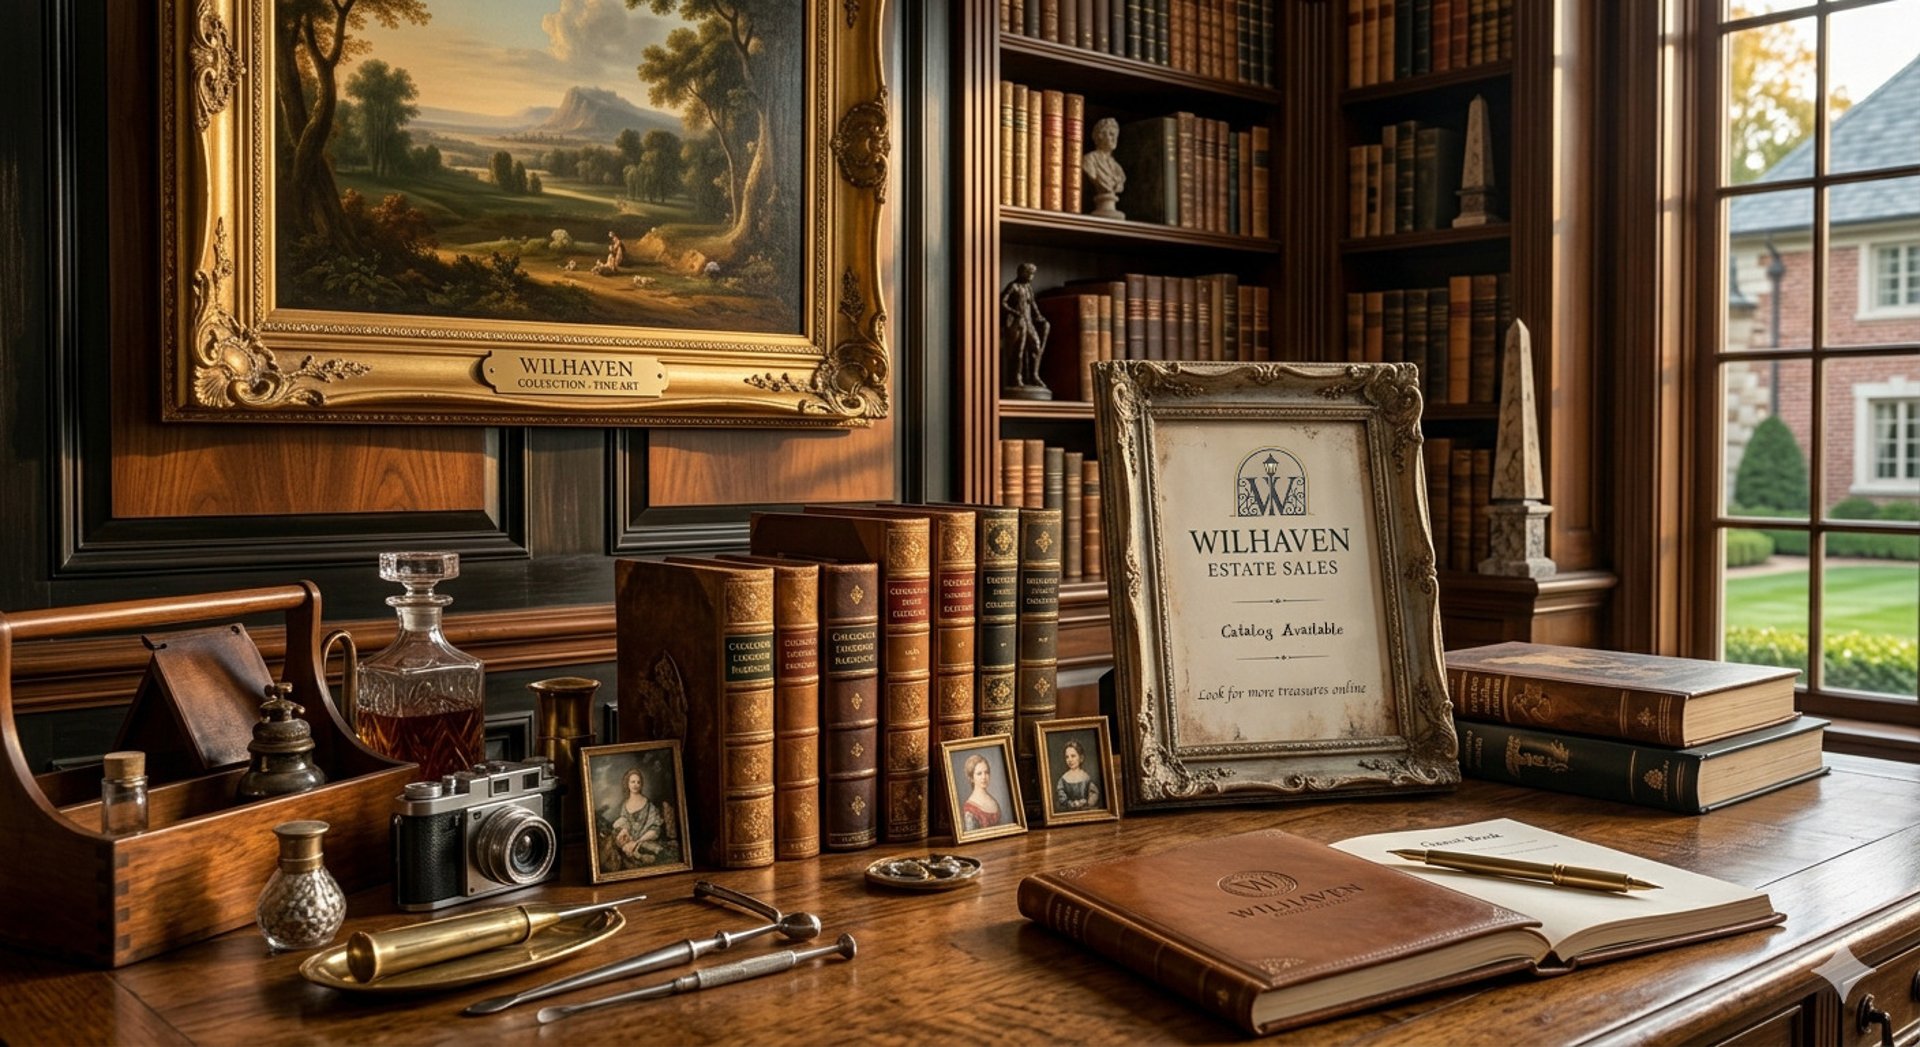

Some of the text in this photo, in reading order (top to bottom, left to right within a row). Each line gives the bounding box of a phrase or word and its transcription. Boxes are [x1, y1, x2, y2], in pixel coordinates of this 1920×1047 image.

[519, 356, 633, 377] WILHAVEN
[619, 381, 640, 391] ART
[1188, 527, 1350, 554] WILHAVEN
[1208, 560, 1338, 577] ESTATE SALES
[1221, 621, 1344, 641] Catalog Available
[1197, 680, 1367, 704] Look for more treasures online
[1228, 883, 1365, 918] WILHAVEN
